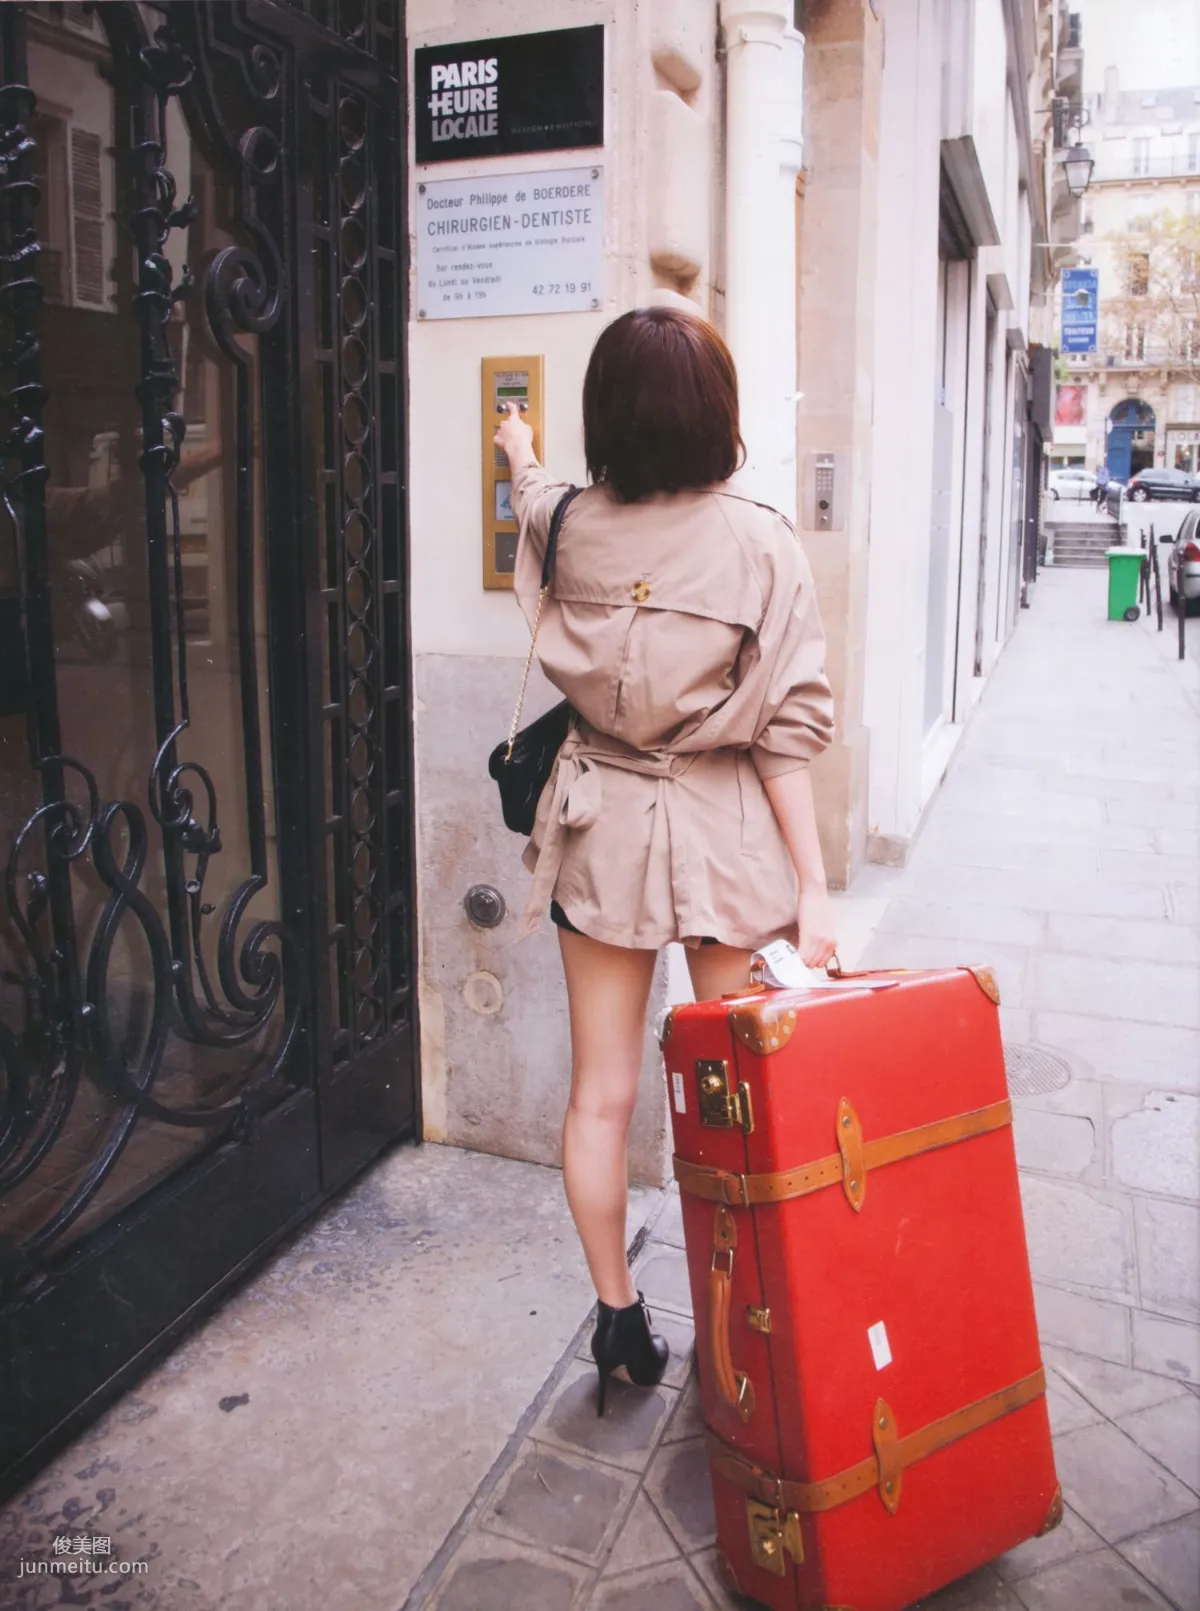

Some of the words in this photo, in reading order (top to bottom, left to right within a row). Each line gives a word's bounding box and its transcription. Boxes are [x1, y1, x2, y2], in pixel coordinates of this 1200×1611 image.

[431, 57, 498, 91] PARIS
[428, 86, 498, 117] HEURE
[432, 112, 498, 142] LOCALE
[427, 197, 464, 210] Docteur
[470, 192, 508, 207] Philippe
[515, 190, 526, 202] de
[533, 184, 591, 201] BOERDERE
[436, 263, 448, 273] Sur
[438, 277, 457, 288] Lundi
[472, 274, 502, 285] Vendredi
[532, 284, 544, 296] 42
[549, 283, 561, 295] 72
[565, 282, 576, 294] 19
[580, 282, 592, 293] 91
